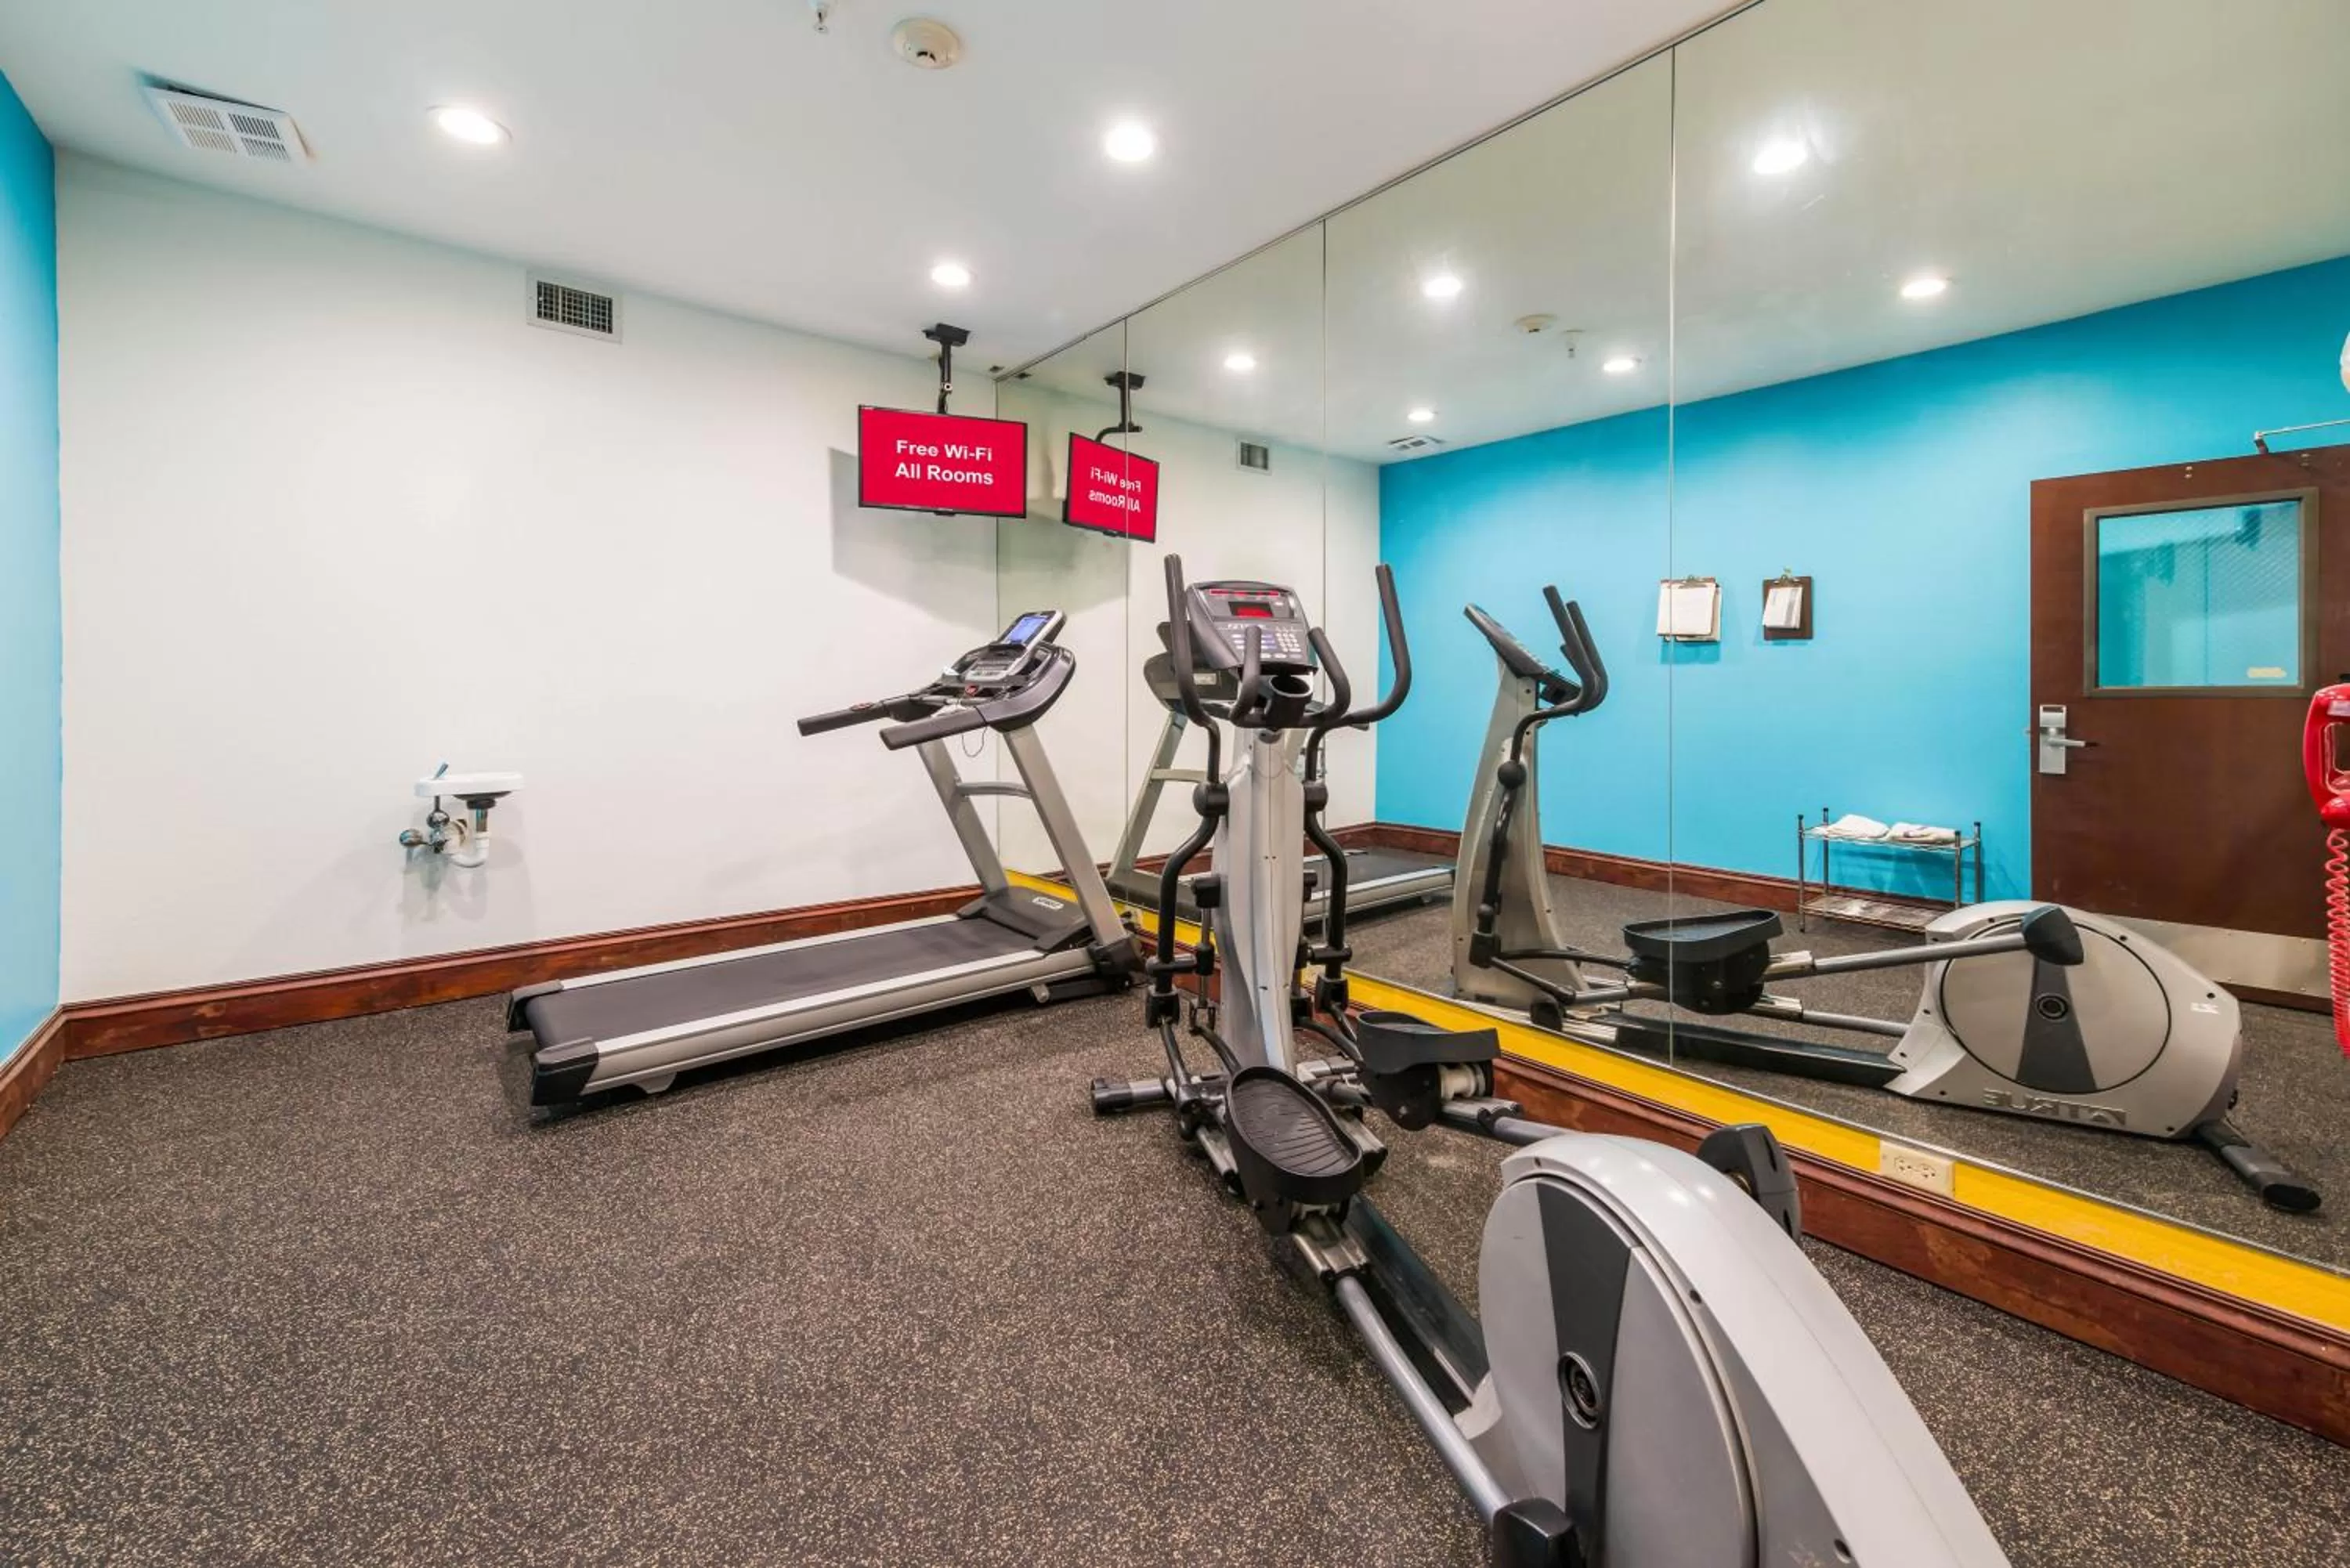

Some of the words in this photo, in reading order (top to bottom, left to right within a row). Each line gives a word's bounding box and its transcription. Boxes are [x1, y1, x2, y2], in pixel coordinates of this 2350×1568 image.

[896, 439, 939, 457] Free
[944, 443, 992, 461] Wi-Fi
[895, 461, 920, 479] All
[927, 464, 993, 485] Rooms
